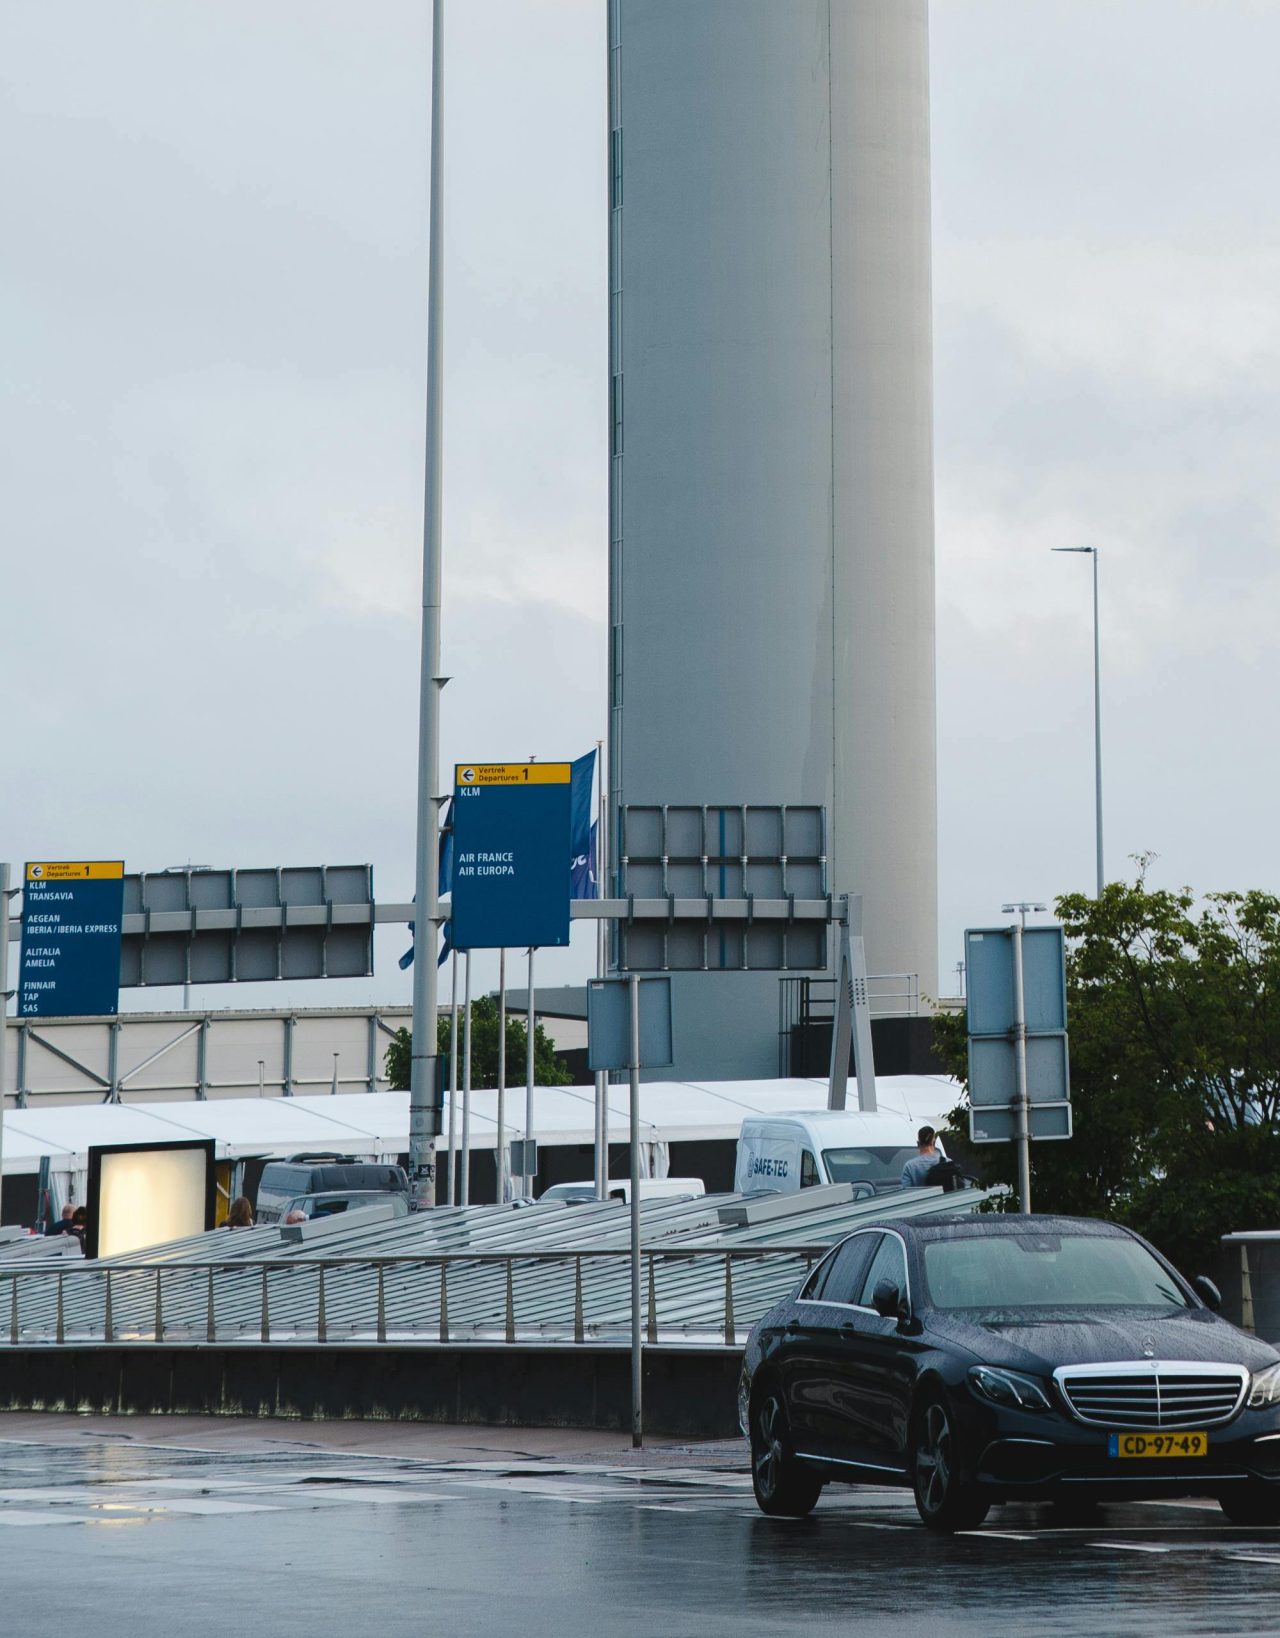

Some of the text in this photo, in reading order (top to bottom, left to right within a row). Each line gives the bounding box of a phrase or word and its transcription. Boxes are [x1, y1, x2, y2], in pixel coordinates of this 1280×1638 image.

[478, 767, 506, 775] Vertrek
[522, 767, 529, 781] 1
[478, 775, 519, 783] Departures
[460, 786, 481, 797] KLM
[458, 852, 514, 863] AIR FRANCE
[83, 865, 90, 877] 1
[458, 865, 515, 876] AIR EUROPA
[29, 881, 47, 890] KLM
[28, 892, 74, 901] TRANSAVIA
[27, 914, 61, 923] AEGEAN
[26, 926, 53, 934] IBERIA
[57, 925, 83, 934] IBERIA
[84, 924, 118, 933] EXPRESS
[25, 947, 61, 957] ALITALIA
[25, 958, 56, 968] AMELIA
[23, 981, 56, 991] FINNAIR
[23, 992, 39, 1001] TAP
[22, 1003, 39, 1013] SAS
[754, 1158, 788, 1178] SAFE-TEC
[1123, 1436, 1202, 1455] CD-97-49
